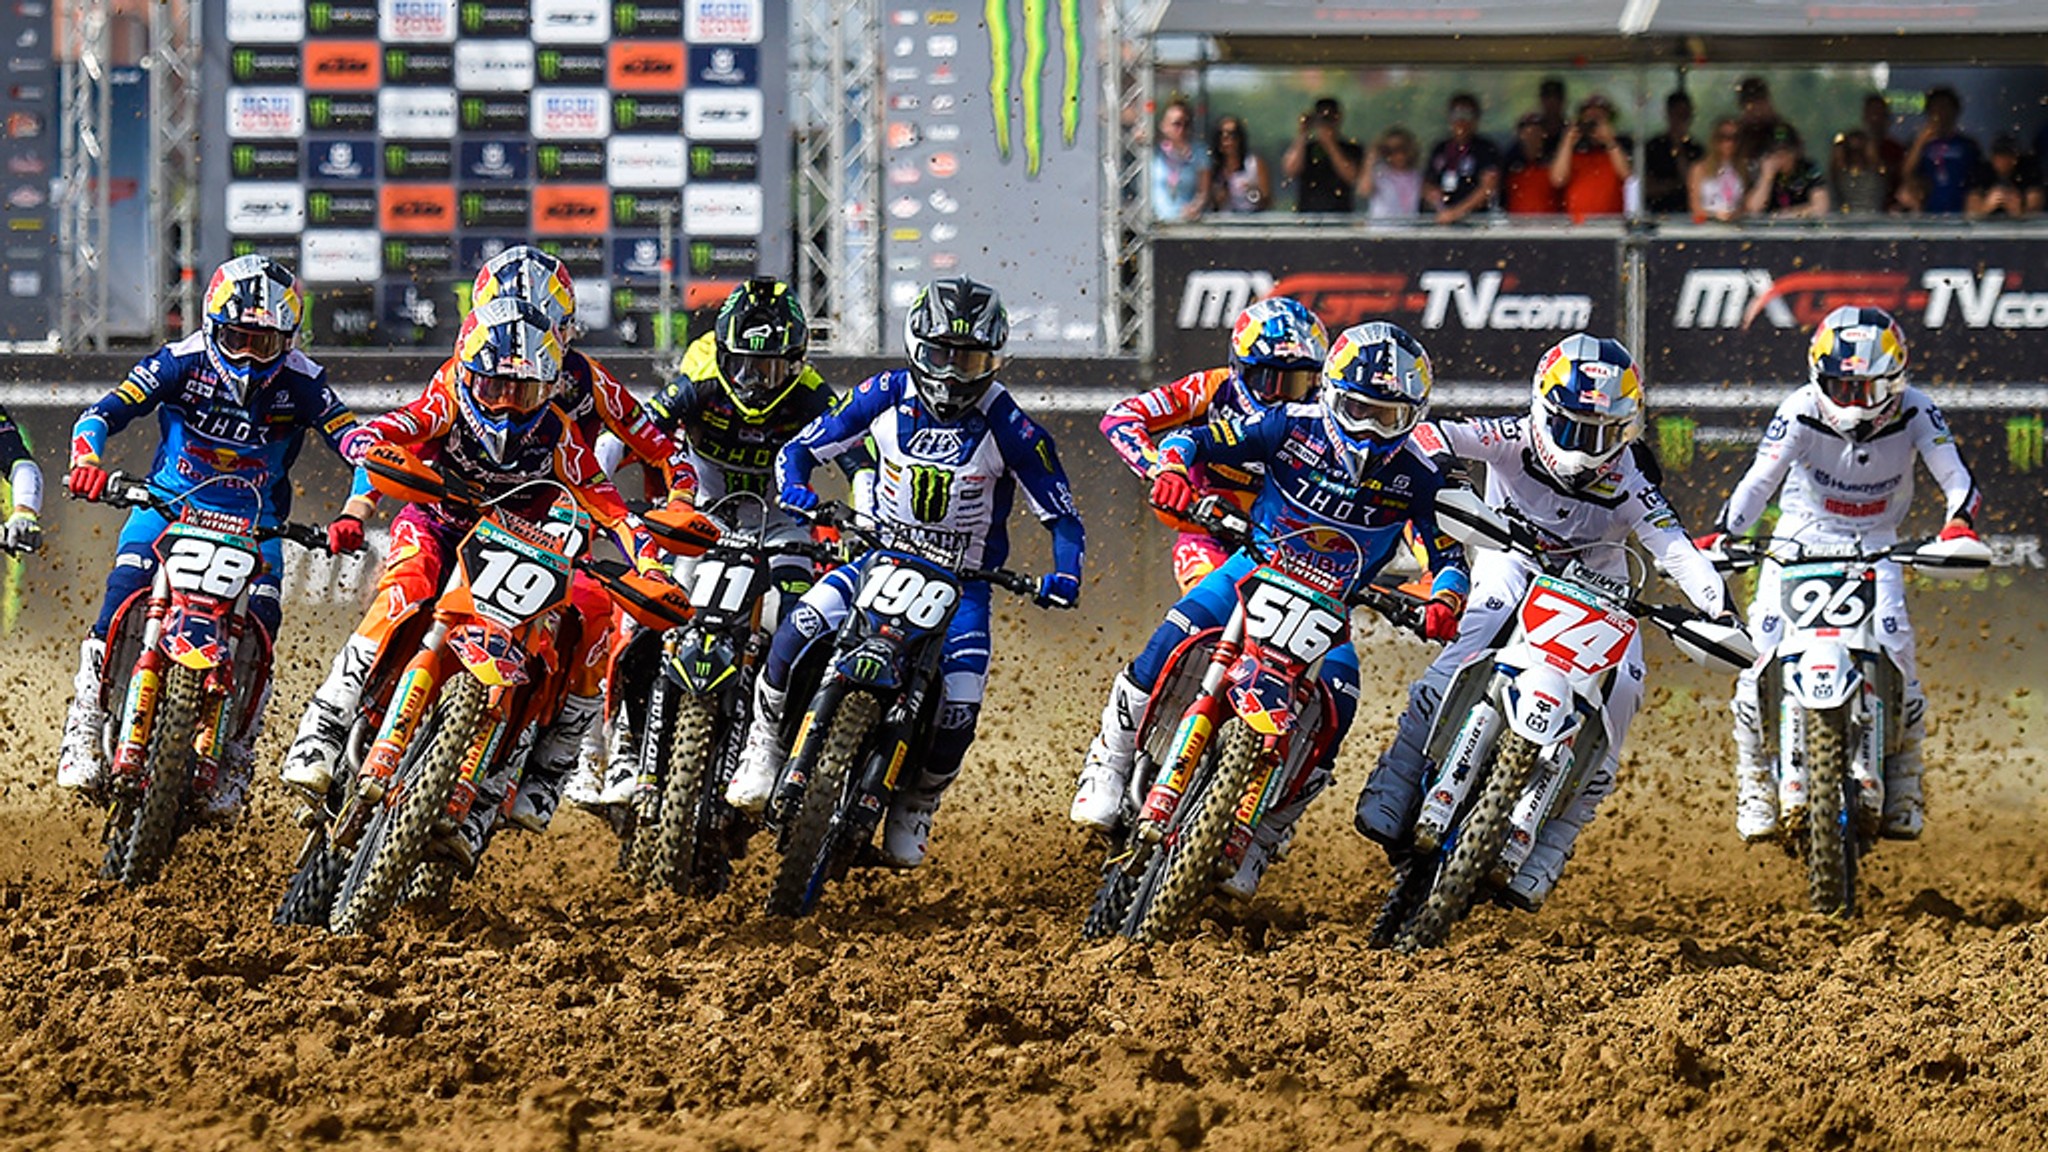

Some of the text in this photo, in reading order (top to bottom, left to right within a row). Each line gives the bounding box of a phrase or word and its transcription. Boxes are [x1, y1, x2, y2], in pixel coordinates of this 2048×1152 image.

[373, 448, 405, 466] KTM
[490, 530, 540, 558] MOTOREX
[689, 519, 721, 542] KTM
[165, 538, 256, 599] 28
[470, 548, 557, 616] 19
[690, 560, 756, 613] 11
[855, 564, 957, 629] 198
[662, 591, 691, 613] KTM
[1247, 582, 1344, 664] 516
[1790, 579, 1866, 628] 96
[1526, 593, 1626, 671] 74
[394, 685, 426, 743] PIREI
[645, 689, 665, 774] DUNLOP
[722, 699, 747, 782] DUNLP
[1173, 731, 1206, 787] PIREI
[1455, 724, 1482, 784] DUNL
